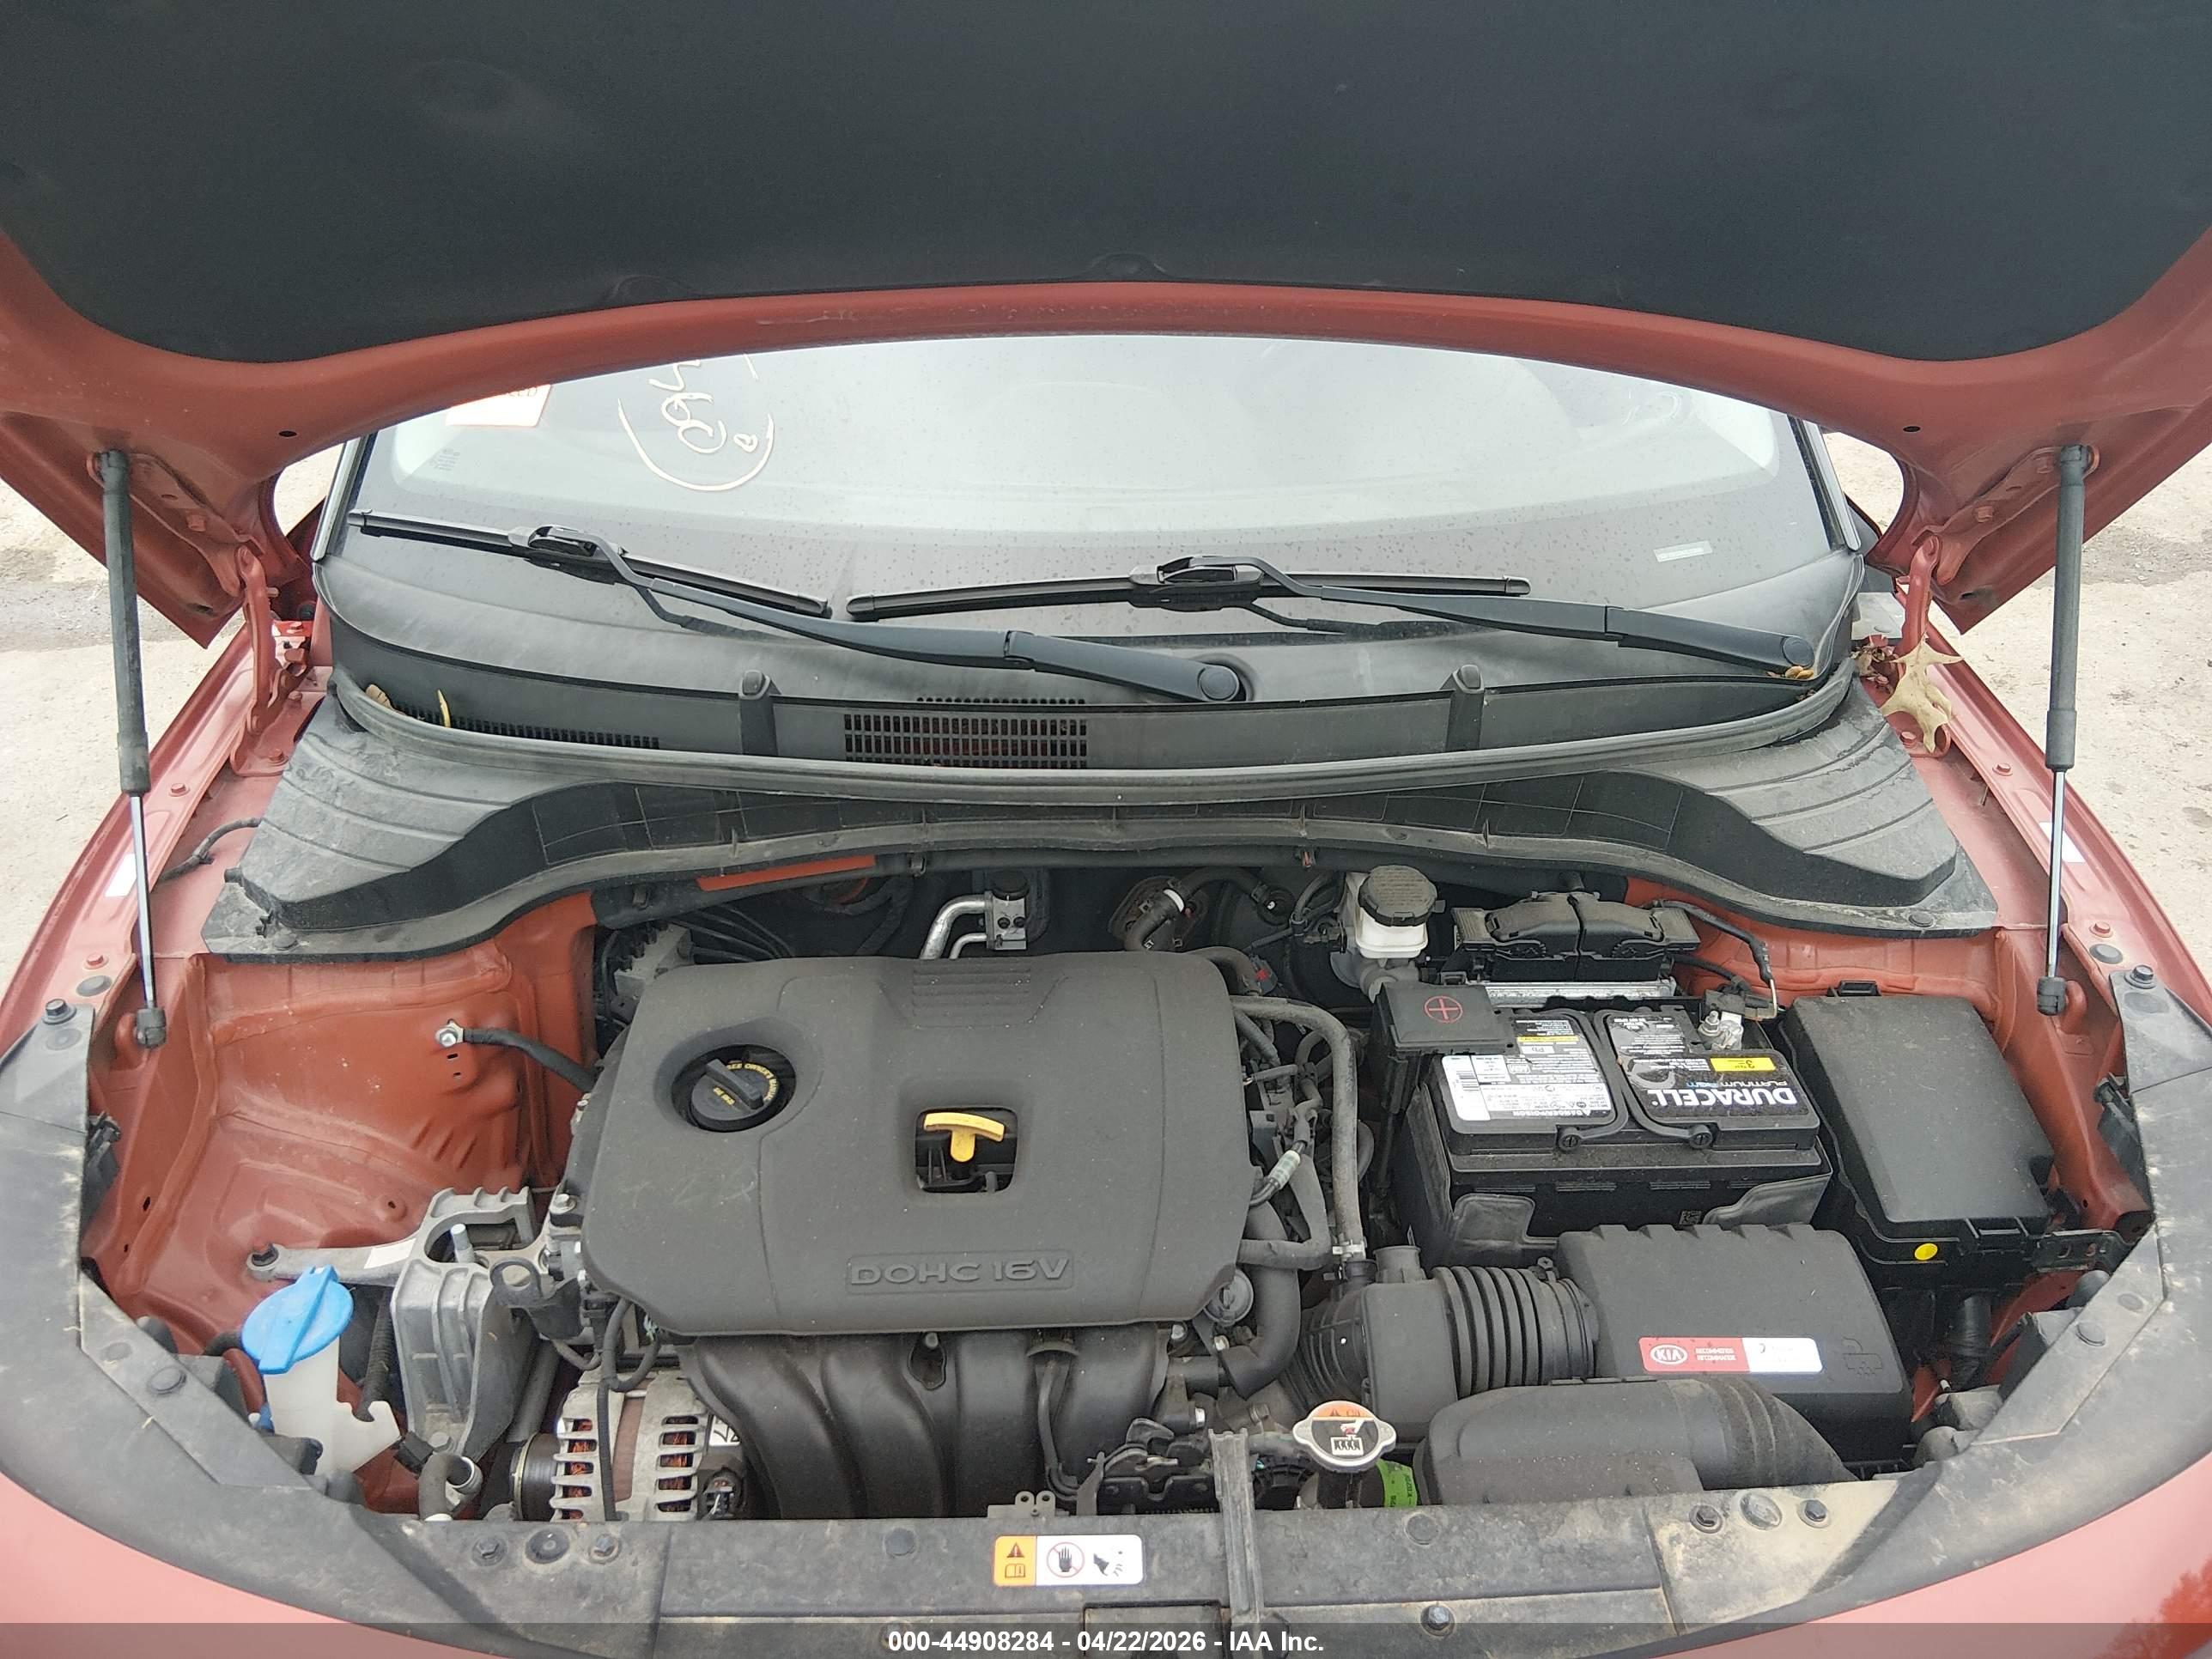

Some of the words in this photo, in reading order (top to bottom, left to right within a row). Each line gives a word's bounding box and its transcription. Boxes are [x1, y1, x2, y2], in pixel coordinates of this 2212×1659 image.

[1745, 1060, 1755, 1069] 3
[1647, 1087, 1798, 1107] DURACELL
[850, 1262, 981, 1285] DOHC
[993, 1257, 1070, 1282] 16V
